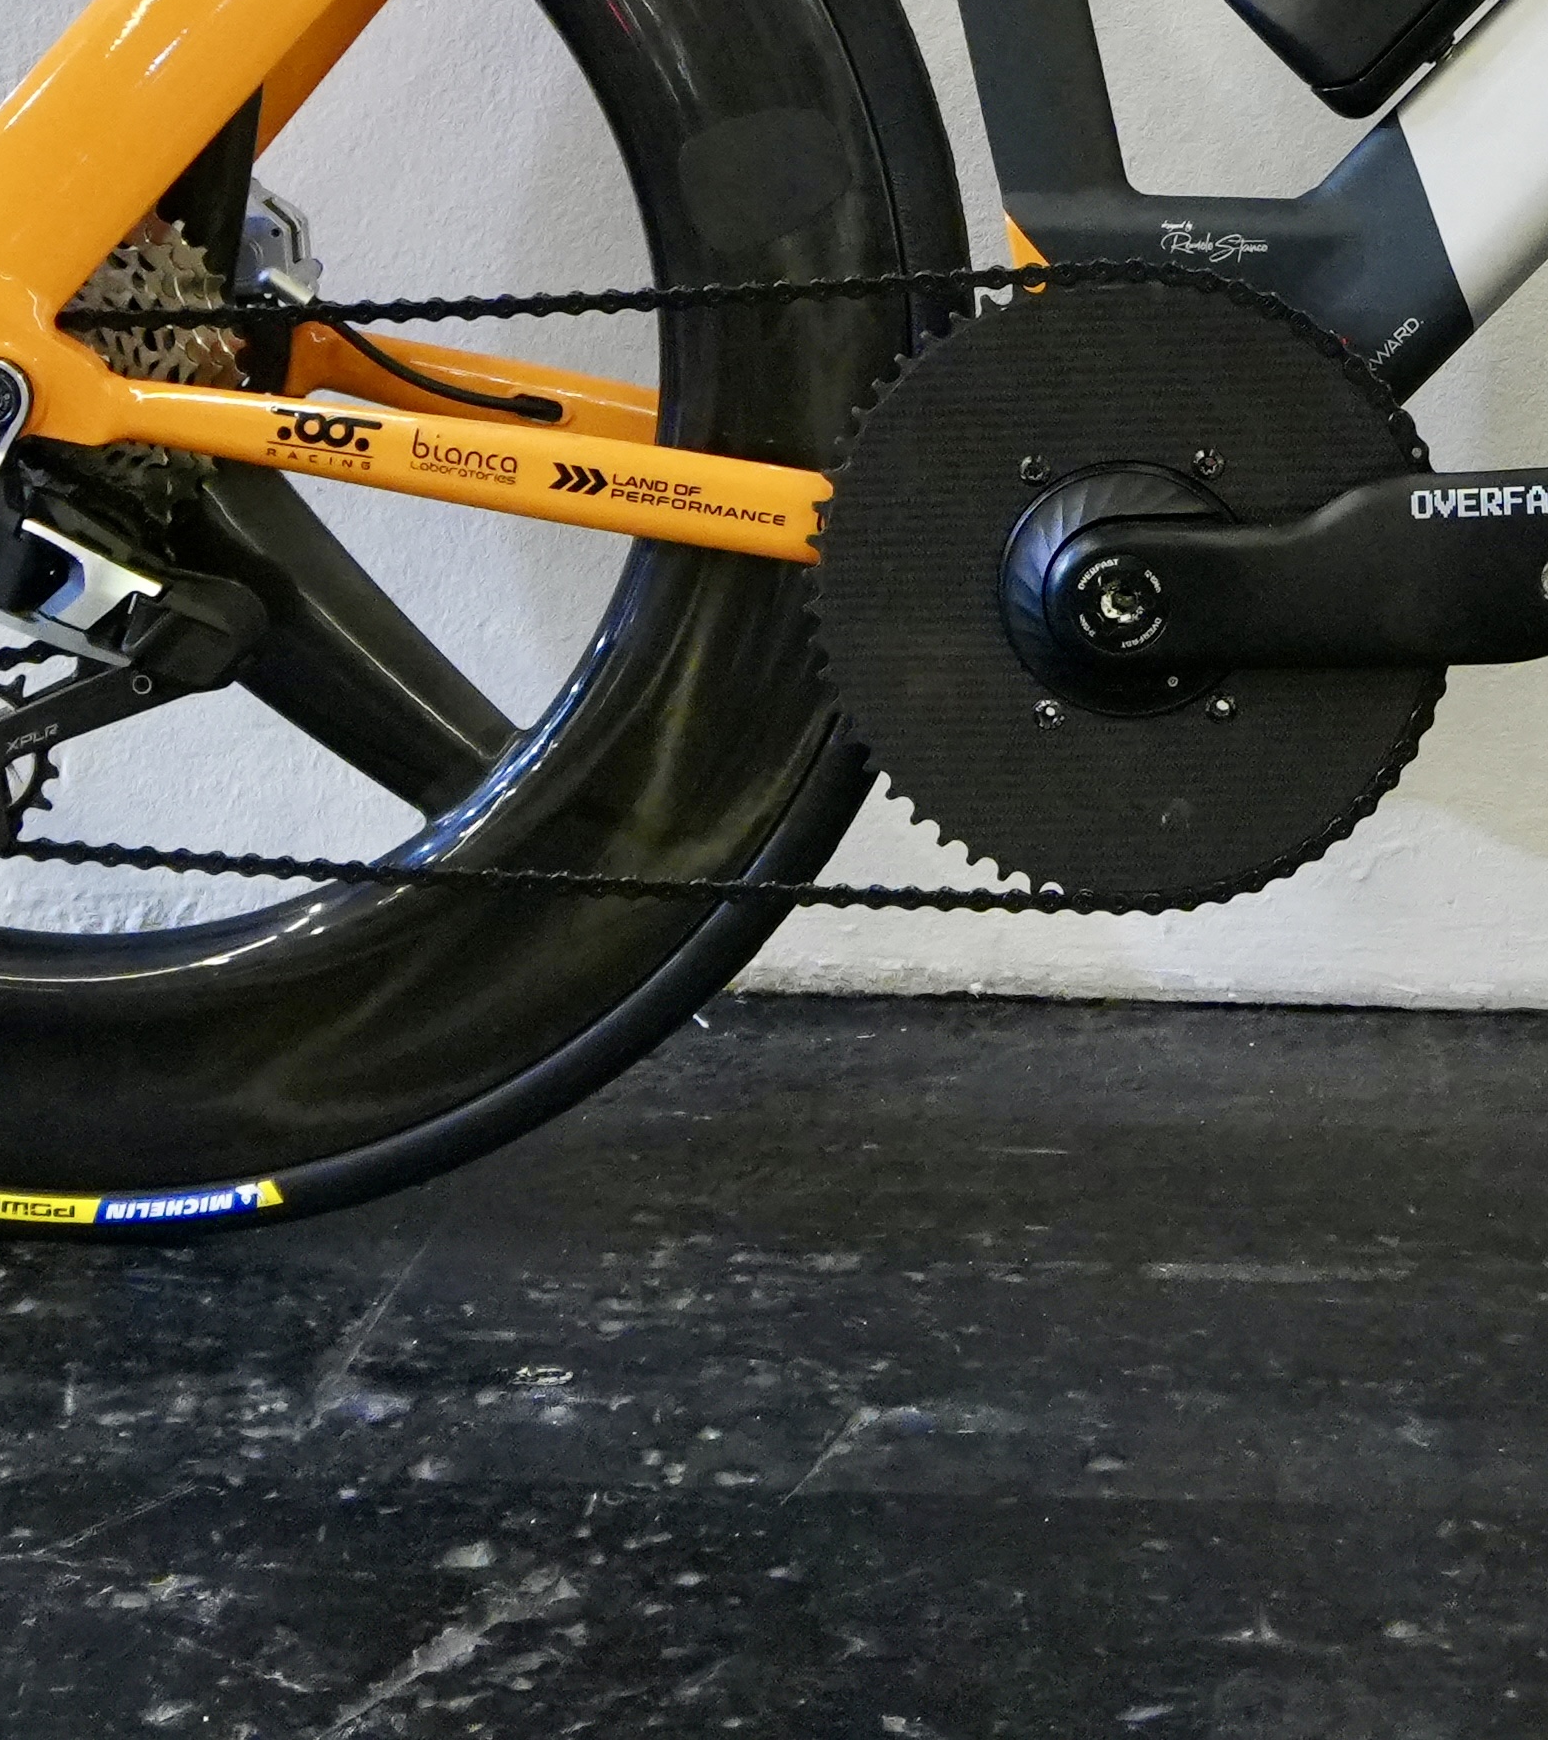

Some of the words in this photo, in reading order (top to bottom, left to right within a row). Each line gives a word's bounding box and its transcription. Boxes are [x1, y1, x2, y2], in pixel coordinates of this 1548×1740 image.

[265, 447, 372, 471] RACING
[412, 427, 518, 474] bianca
[612, 473, 669, 494] LAND
[673, 483, 702, 498] OF
[610, 488, 787, 527] PERFORMANCE
[5, 722, 60, 755] XPLR
[105, 1192, 233, 1221] MICHELIN
